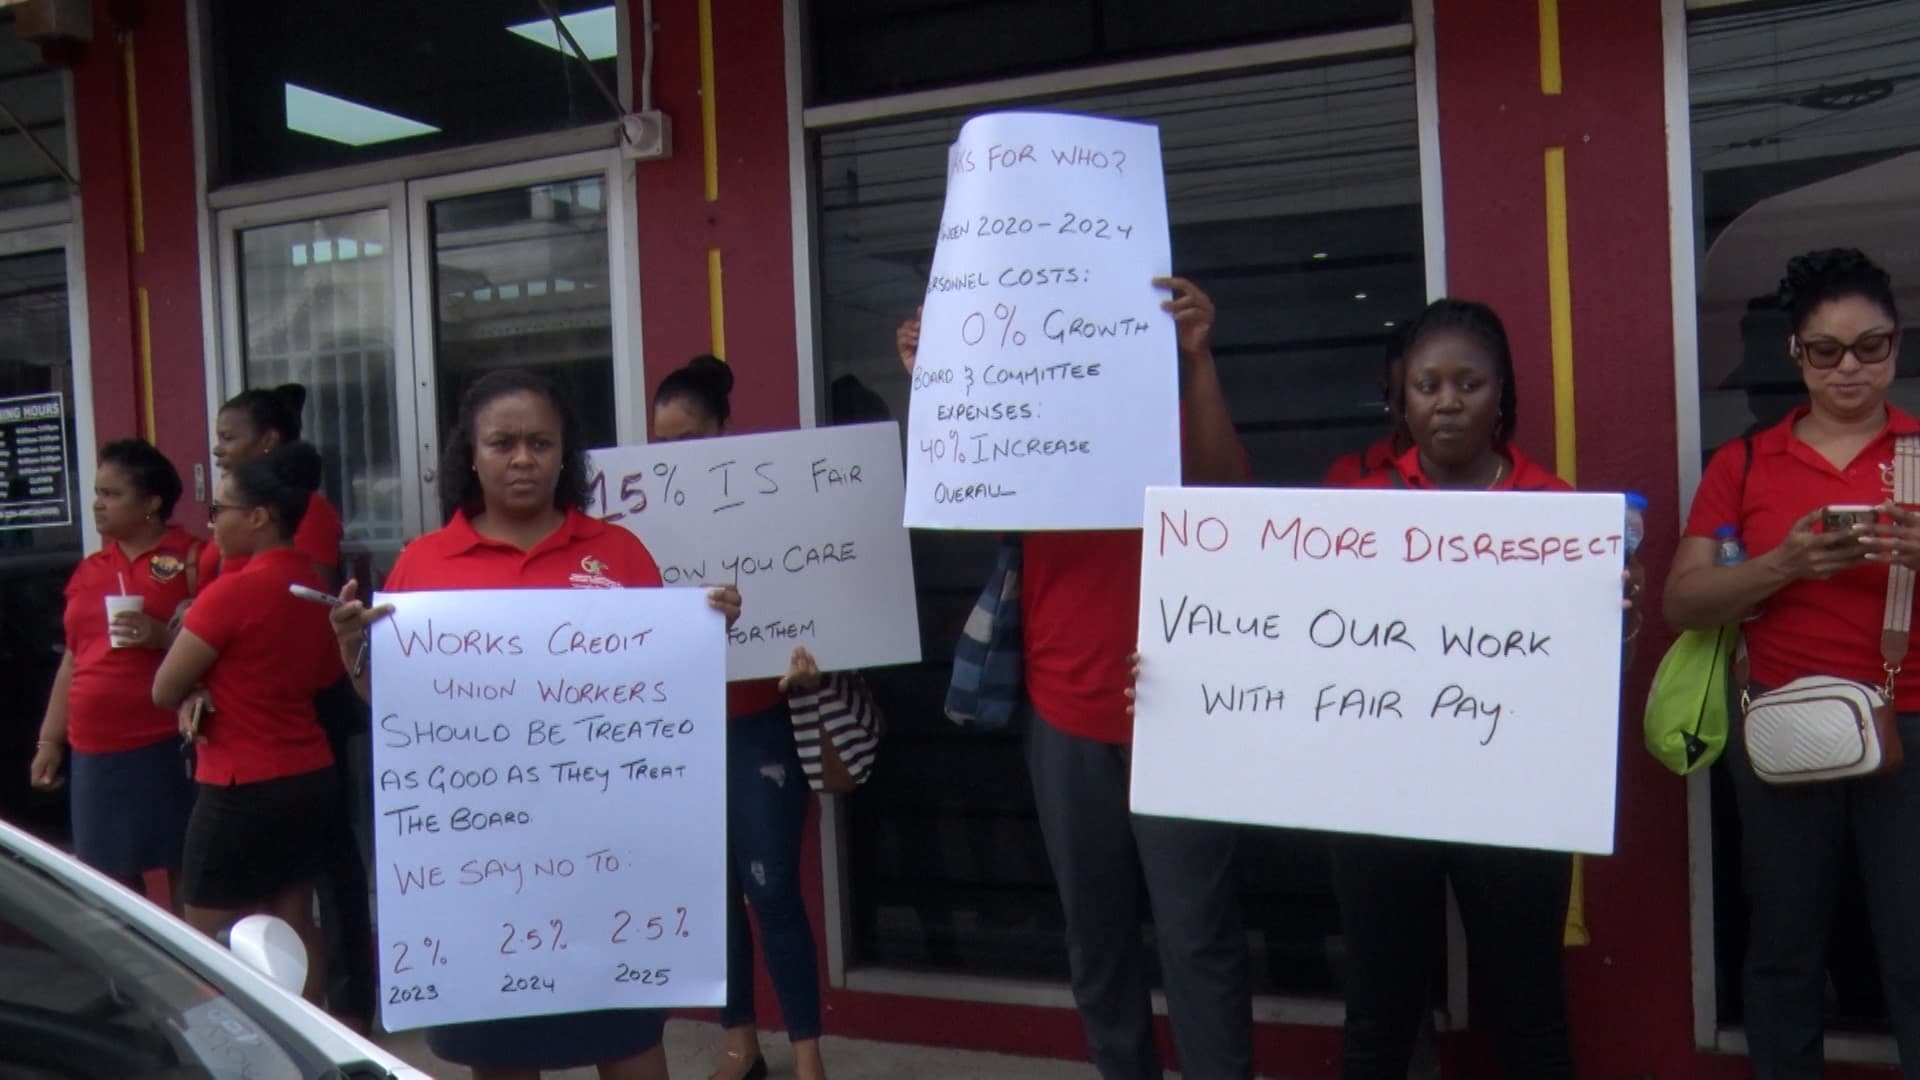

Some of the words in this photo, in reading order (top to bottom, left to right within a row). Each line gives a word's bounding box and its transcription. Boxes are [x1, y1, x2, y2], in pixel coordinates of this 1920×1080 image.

[988, 144, 1037, 171] FOR
[1052, 145, 1127, 174] WHO?
[998, 268, 1089, 286] COSTS:
[962, 303, 1026, 348] 0%
[1043, 309, 1150, 343] GROWTH
[913, 365, 954, 391] BOARD
[983, 363, 1102, 386] COMMITTEE
[937, 402, 1042, 421] EXPENSES:
[920, 429, 967, 464] 40%
[970, 433, 1091, 464] INCREASE
[591, 462, 685, 521] 15%
[811, 458, 863, 493] FAIR
[934, 482, 1017, 504] OVERALL
[1159, 510, 1229, 557] NO
[1261, 517, 1378, 560] MORE
[1403, 527, 1623, 565] DISRESPECT
[783, 543, 856, 573] CARE
[389, 613, 524, 657] WORKS
[548, 622, 653, 655] CREDIT
[727, 626, 764, 645] FOR
[767, 619, 816, 640] THEM
[1159, 595, 1281, 644] VALUE
[1309, 609, 1416, 651] OUR
[1442, 625, 1551, 659] WORK
[433, 679, 516, 700] UNION
[537, 680, 668, 704] WORKERS
[1201, 683, 1284, 717] WITH
[1315, 684, 1402, 722] FAIR
[381, 714, 510, 748] SHOULD
[527, 720, 566, 746] BE
[573, 715, 694, 743] TREATED
[380, 770, 419, 792] AS
[428, 765, 498, 794] GOOD
[507, 765, 540, 784] AS
[550, 761, 609, 792] THEY
[620, 759, 687, 780] TREAT
[384, 805, 440, 835] THE
[393, 863, 445, 895] WE
[459, 859, 524, 894] SAY
[534, 859, 575, 878] NO
[389, 984, 439, 1005] 2023
[501, 976, 555, 993] 2024
[615, 963, 671, 986] 2025
